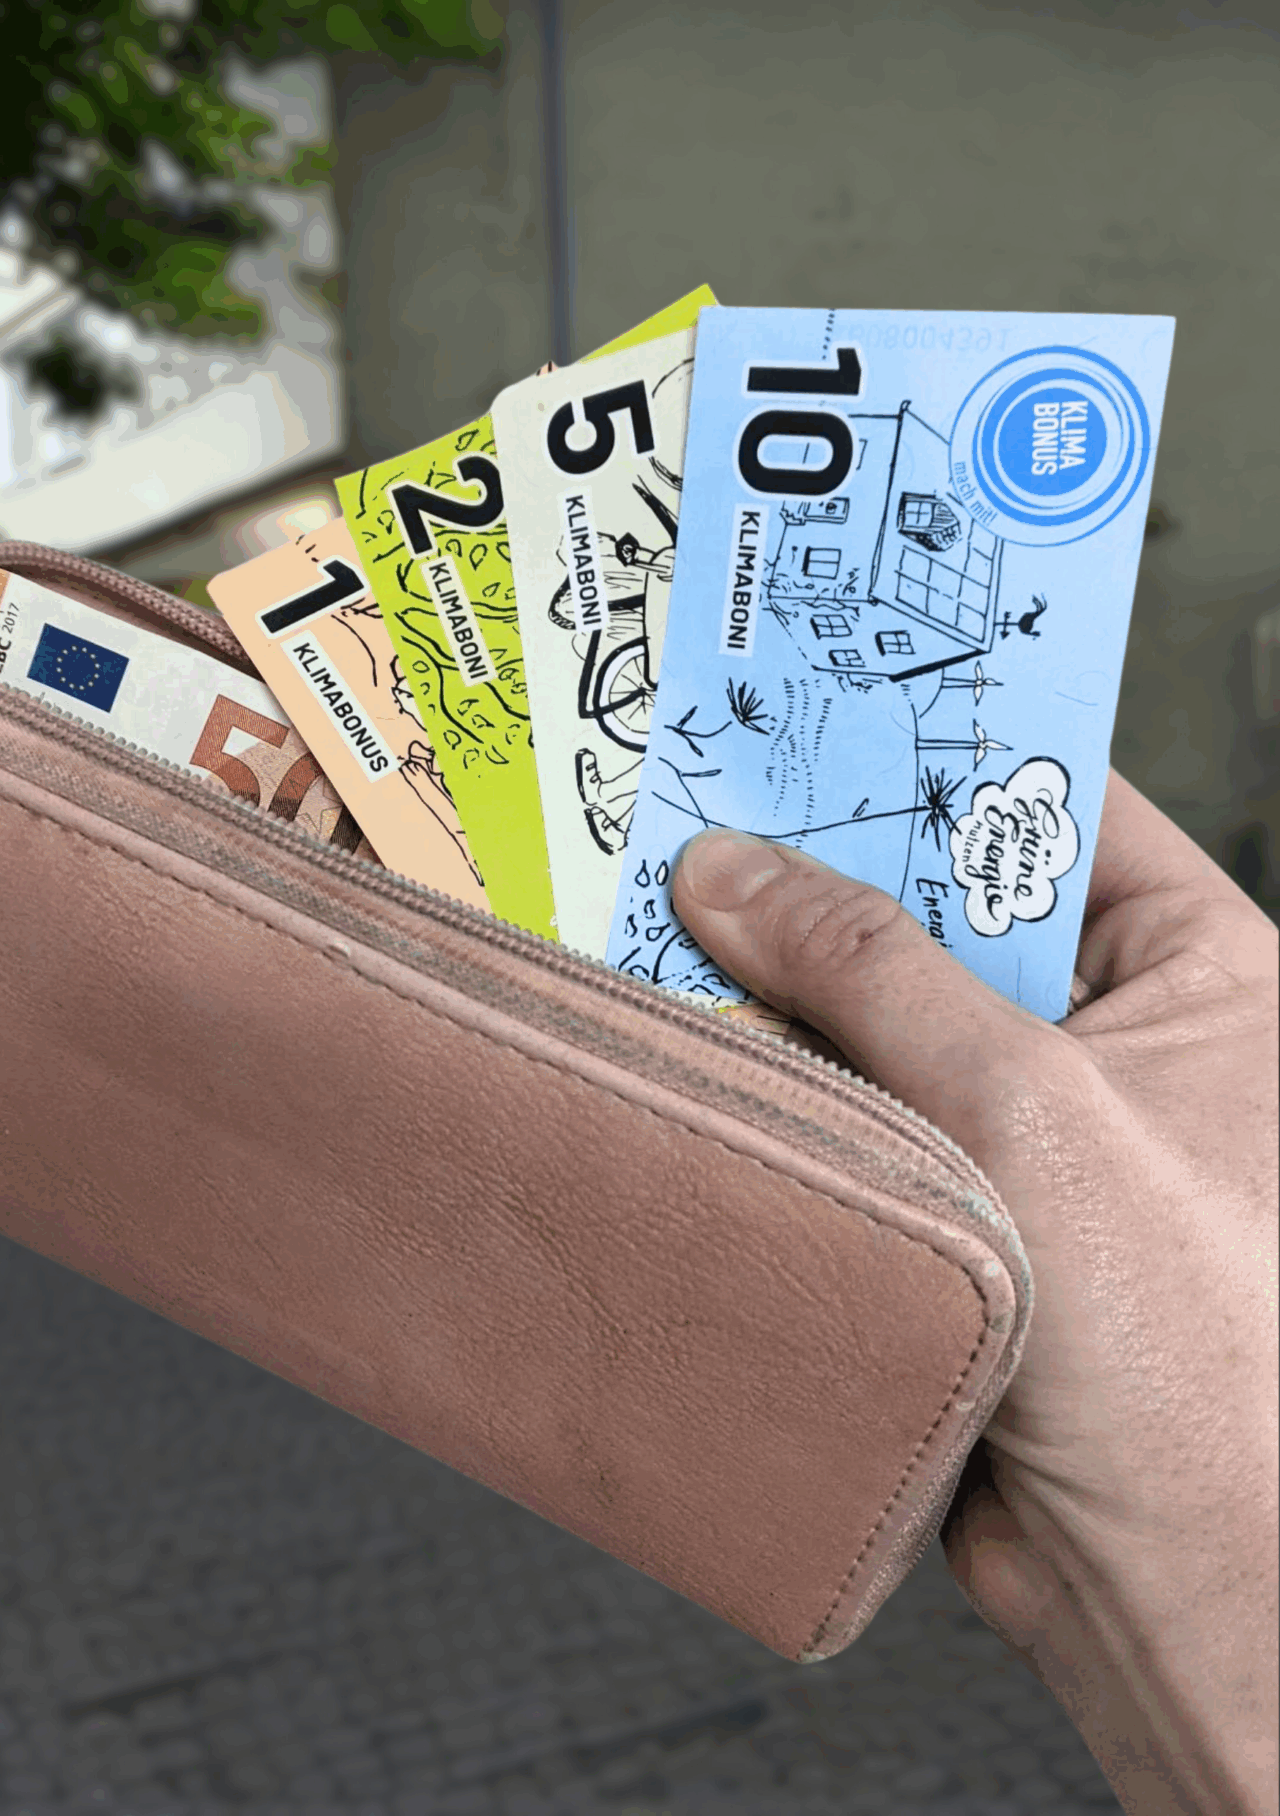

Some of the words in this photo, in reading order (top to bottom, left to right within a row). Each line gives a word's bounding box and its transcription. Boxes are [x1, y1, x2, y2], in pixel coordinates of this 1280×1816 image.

[547, 379, 655, 475] 5
[739, 347, 862, 497] 10
[1031, 402, 1060, 476] BONUS
[1059, 400, 1088, 470] KLIMA
[391, 455, 505, 555] 2
[953, 461, 978, 501] mach
[970, 500, 999, 527] mit!
[260, 559, 365, 633] 1
[565, 494, 602, 626] KLIMABONI
[726, 510, 761, 650] KLIMABONI
[1, 602, 20, 634] 2017
[429, 561, 488, 679] KLIMABONI
[293, 642, 389, 773] KLIMABONUS
[961, 819, 984, 863] nutzen
[963, 804, 1028, 922] Energie
[1013, 787, 1060, 901] Grüne
